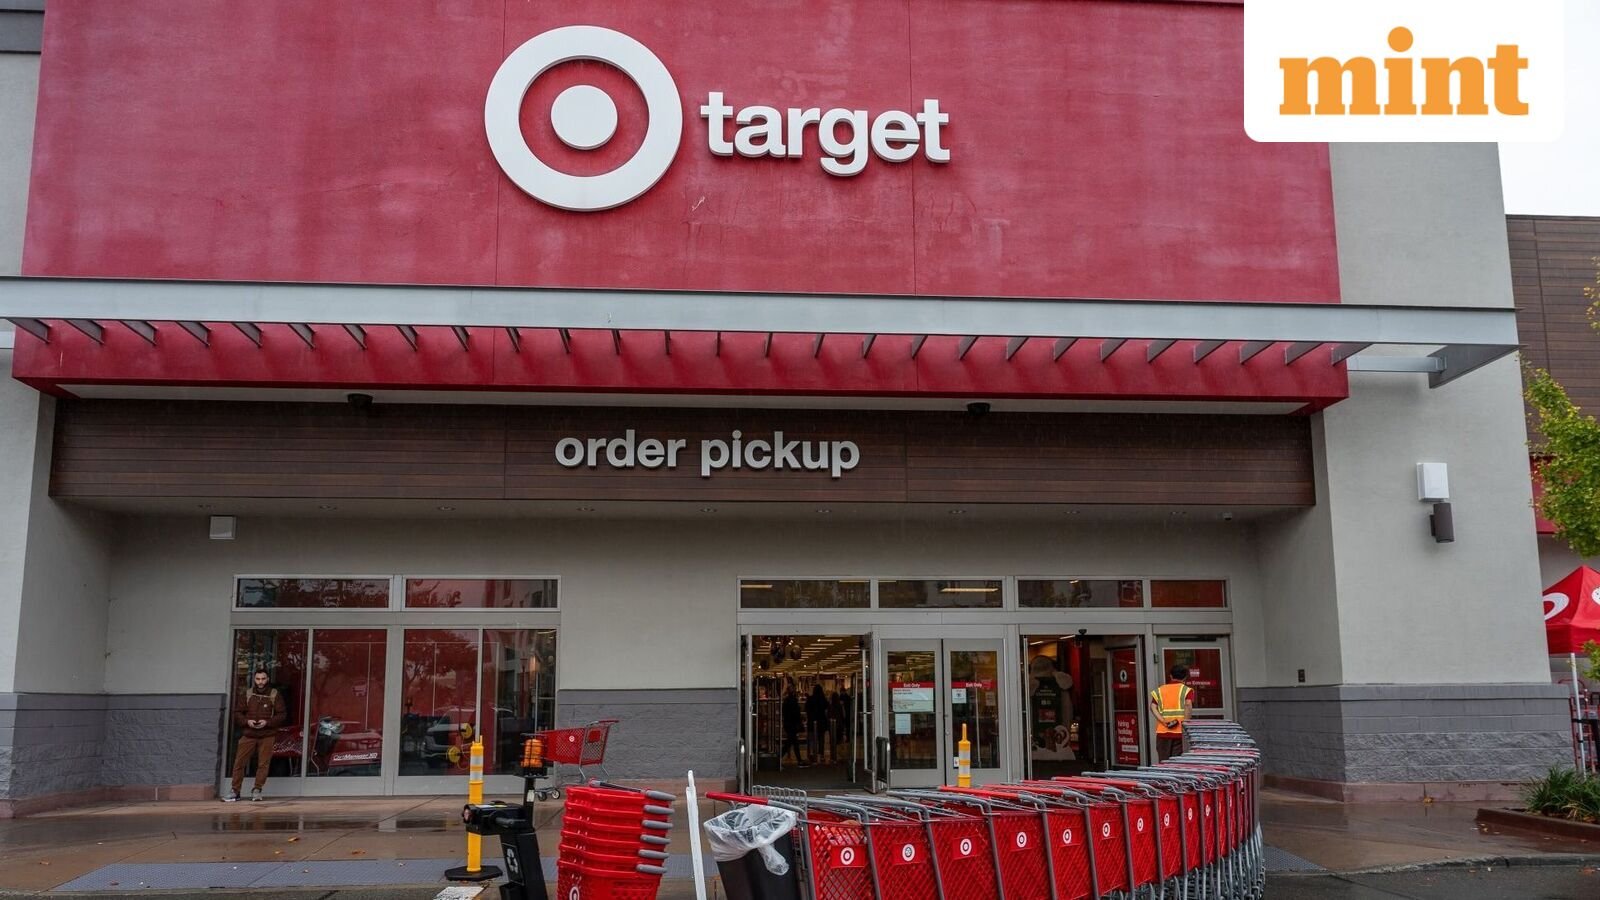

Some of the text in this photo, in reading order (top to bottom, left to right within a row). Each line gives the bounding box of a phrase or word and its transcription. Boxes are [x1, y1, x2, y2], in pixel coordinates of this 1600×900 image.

[700, 91, 950, 177] target
[554, 429, 861, 478] order pickup
